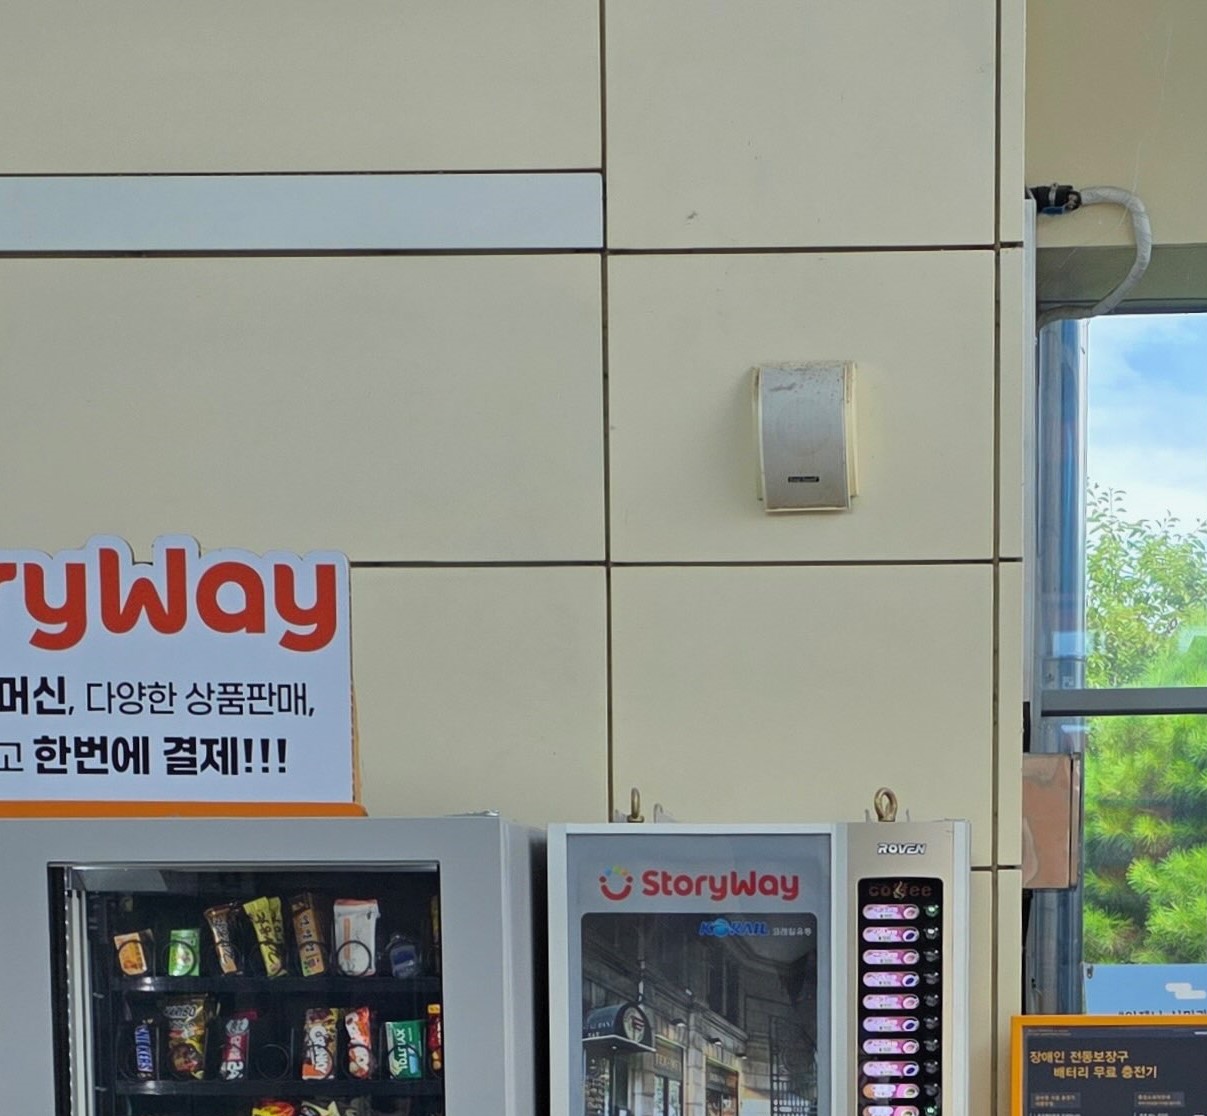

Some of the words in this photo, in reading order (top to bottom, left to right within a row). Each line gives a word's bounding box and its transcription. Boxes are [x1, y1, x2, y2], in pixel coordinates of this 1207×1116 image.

[86, 681, 178, 716] 다양한
[185, 682, 315, 717] 상품판매,
[33, 735, 150, 775] 한번에
[163, 736, 287, 776] 결제!!!
[877, 843, 926, 855] ROVEN
[641, 870, 799, 901] StoryWay
[1029, 1051, 1065, 1064] 장애인
